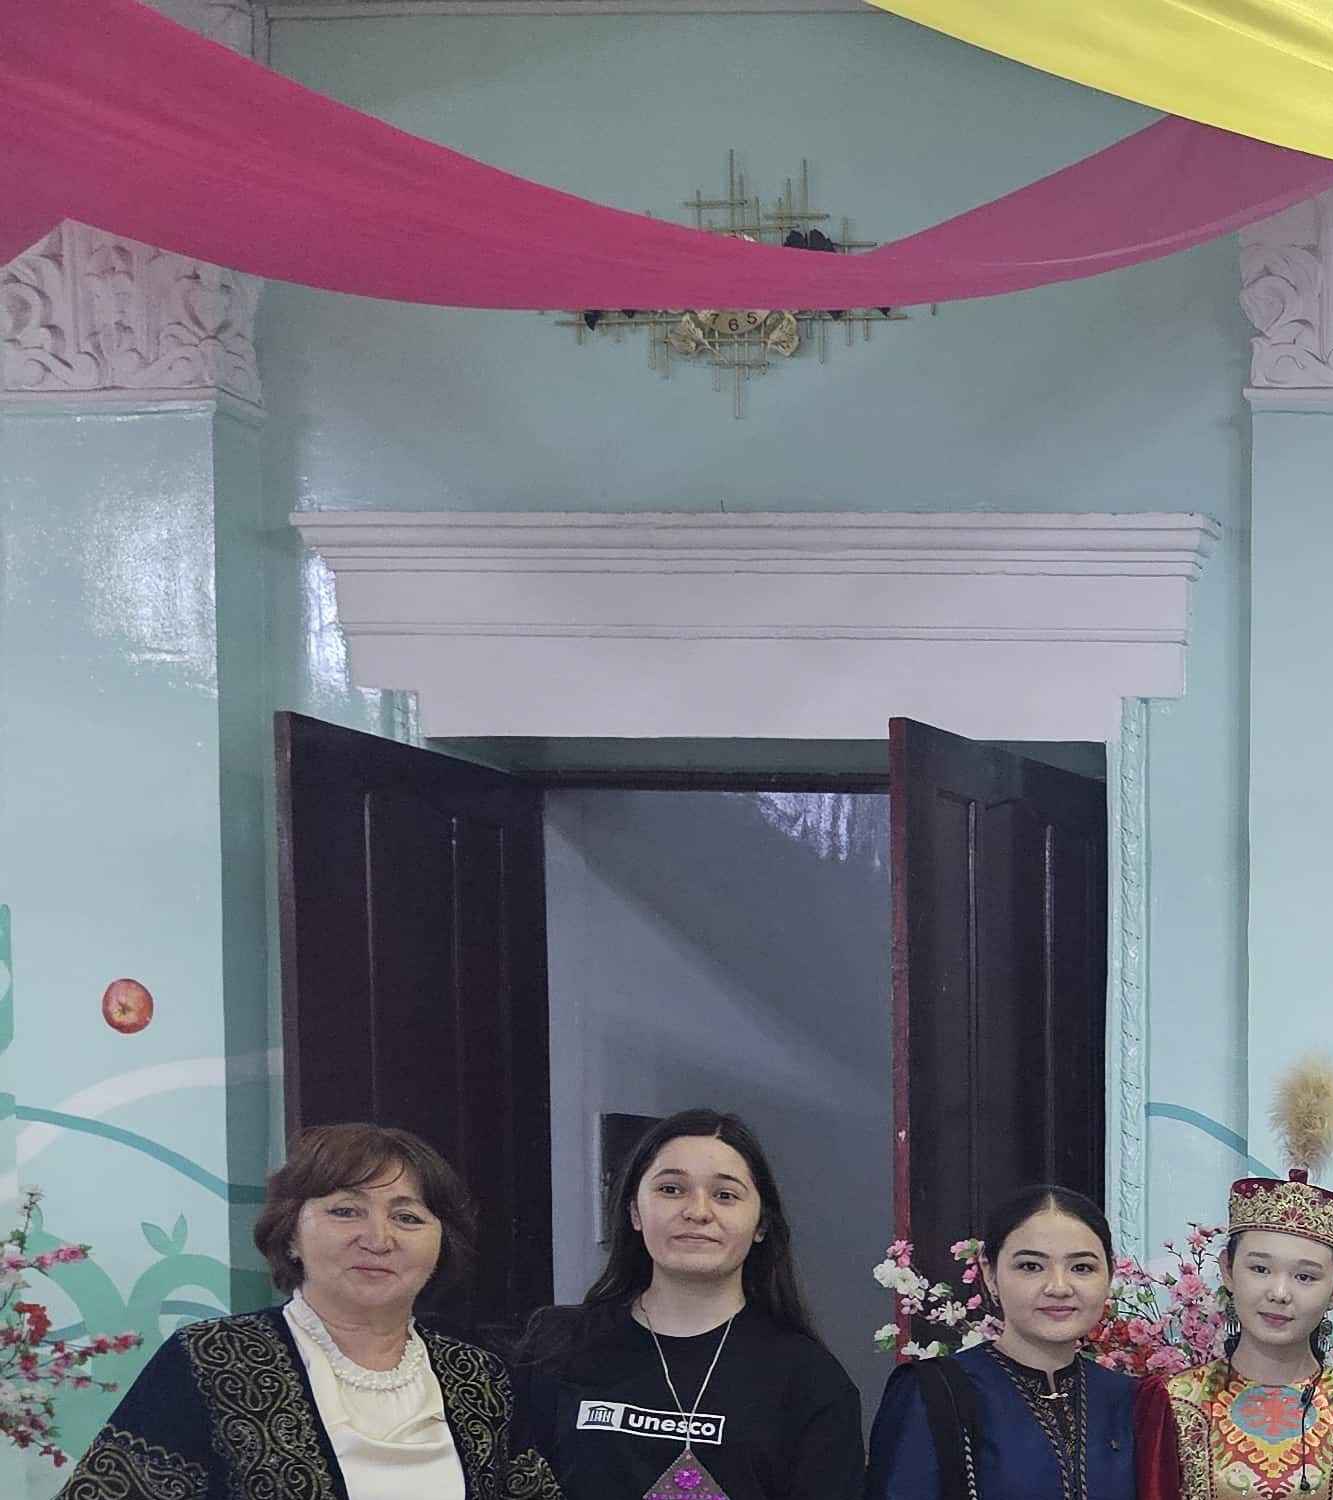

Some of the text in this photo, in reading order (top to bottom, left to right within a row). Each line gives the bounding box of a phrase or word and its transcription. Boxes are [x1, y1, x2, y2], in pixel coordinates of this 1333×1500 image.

[710, 313, 720, 325] 7
[746, 312, 757, 324] 5
[728, 318, 739, 331] 6
[628, 1413, 716, 1436] unesco
